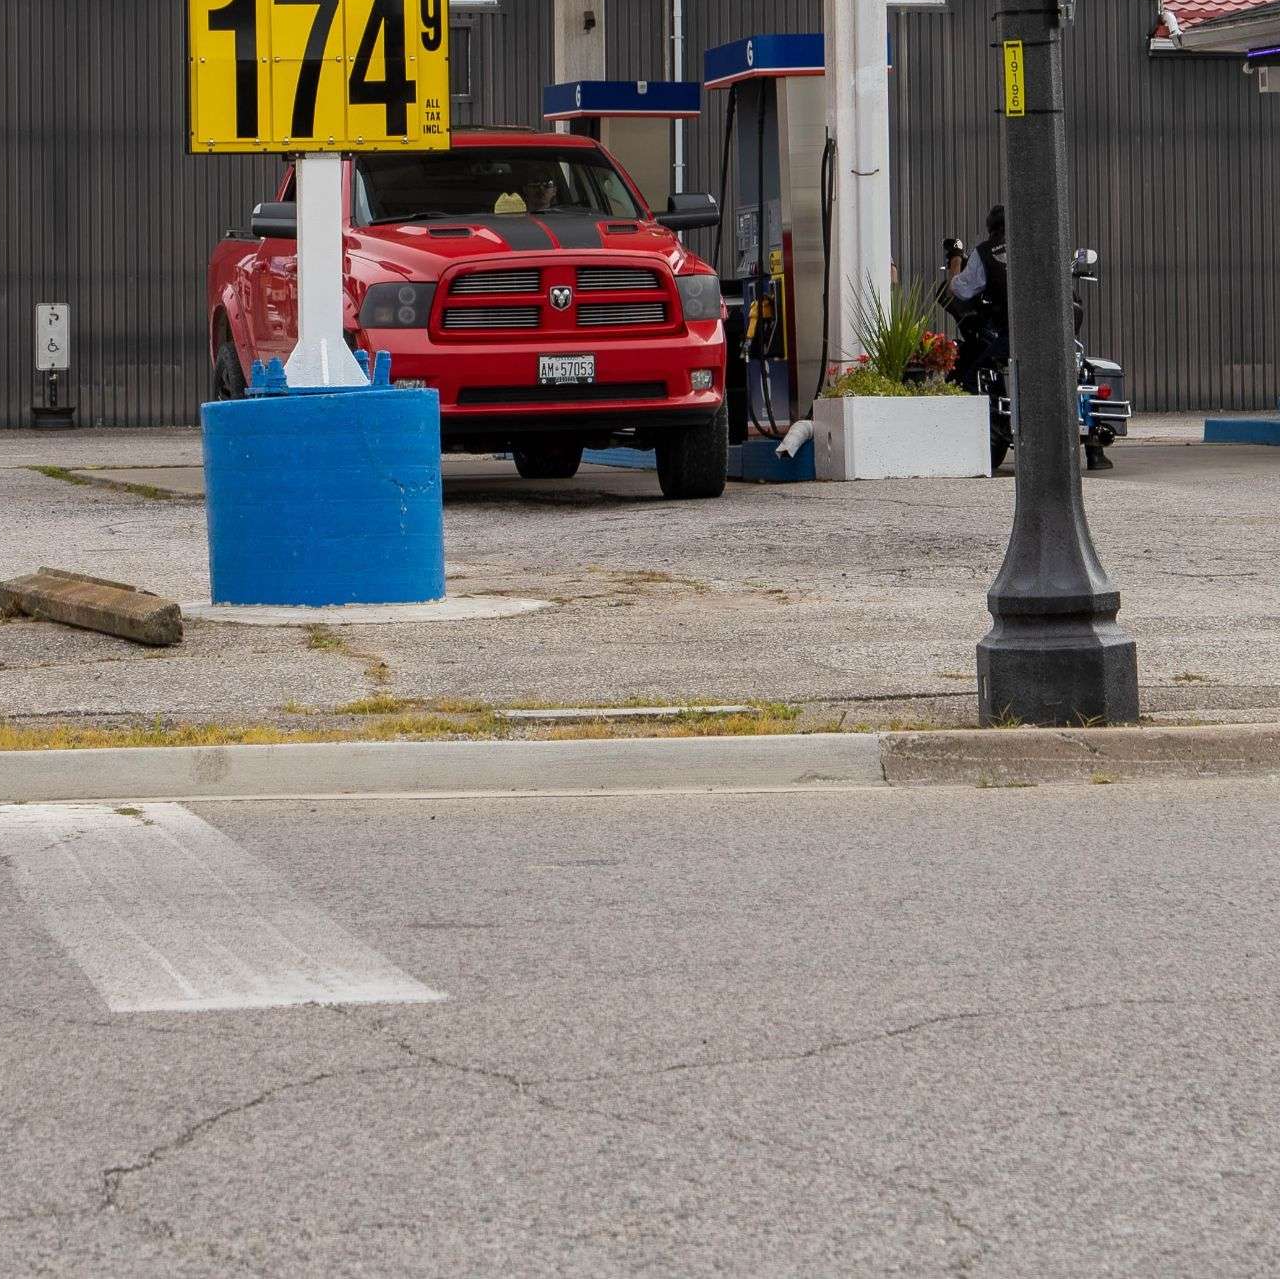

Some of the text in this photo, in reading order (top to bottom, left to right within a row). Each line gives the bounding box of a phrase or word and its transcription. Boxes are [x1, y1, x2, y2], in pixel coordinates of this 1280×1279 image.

[425, 98, 440, 109] ALL
[425, 111, 441, 121] TAX
[423, 124, 443, 134] INCL.
